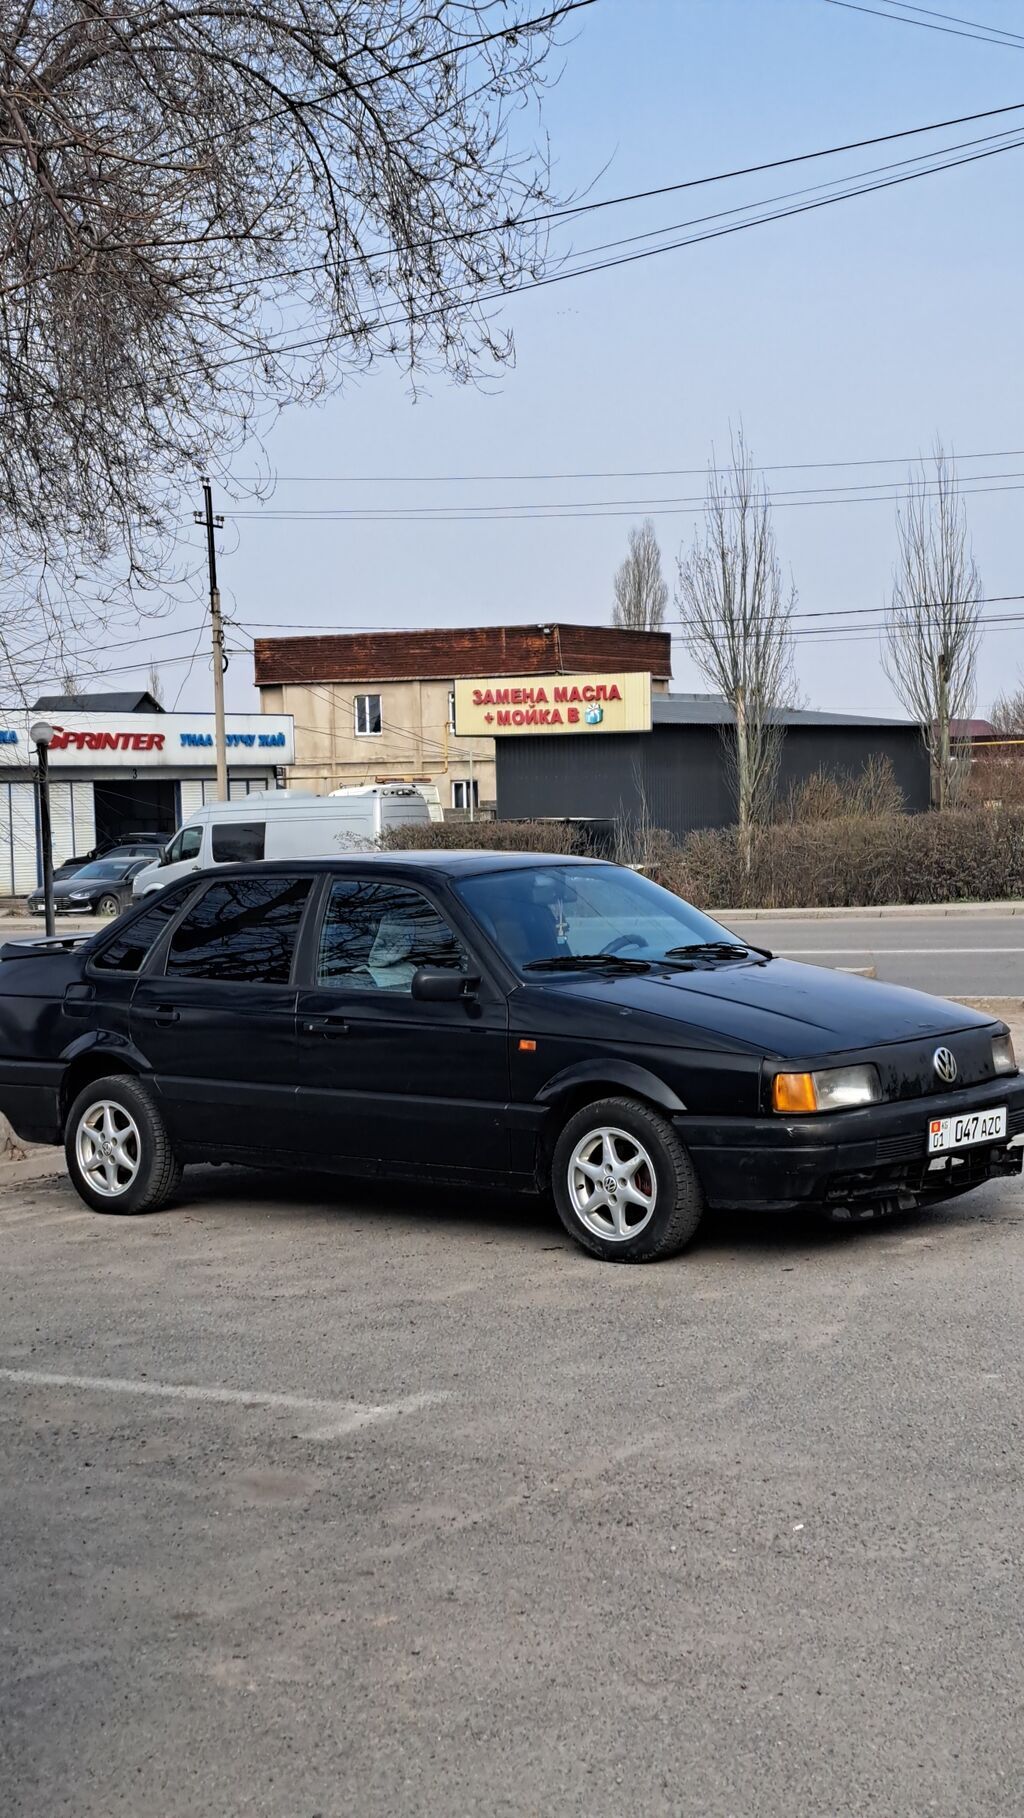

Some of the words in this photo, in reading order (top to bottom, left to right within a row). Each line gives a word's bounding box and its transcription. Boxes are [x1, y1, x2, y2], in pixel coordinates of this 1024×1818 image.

[472, 687, 549, 705] ЗАМЕНА
[553, 684, 622, 702] МАСЛА
[567, 708, 580, 723] В
[48, 725, 166, 751] SPRINTER
[225, 734, 256, 747] УУЧУ
[132, 768, 138, 780] 3
[933, 1133, 944, 1148] 01
